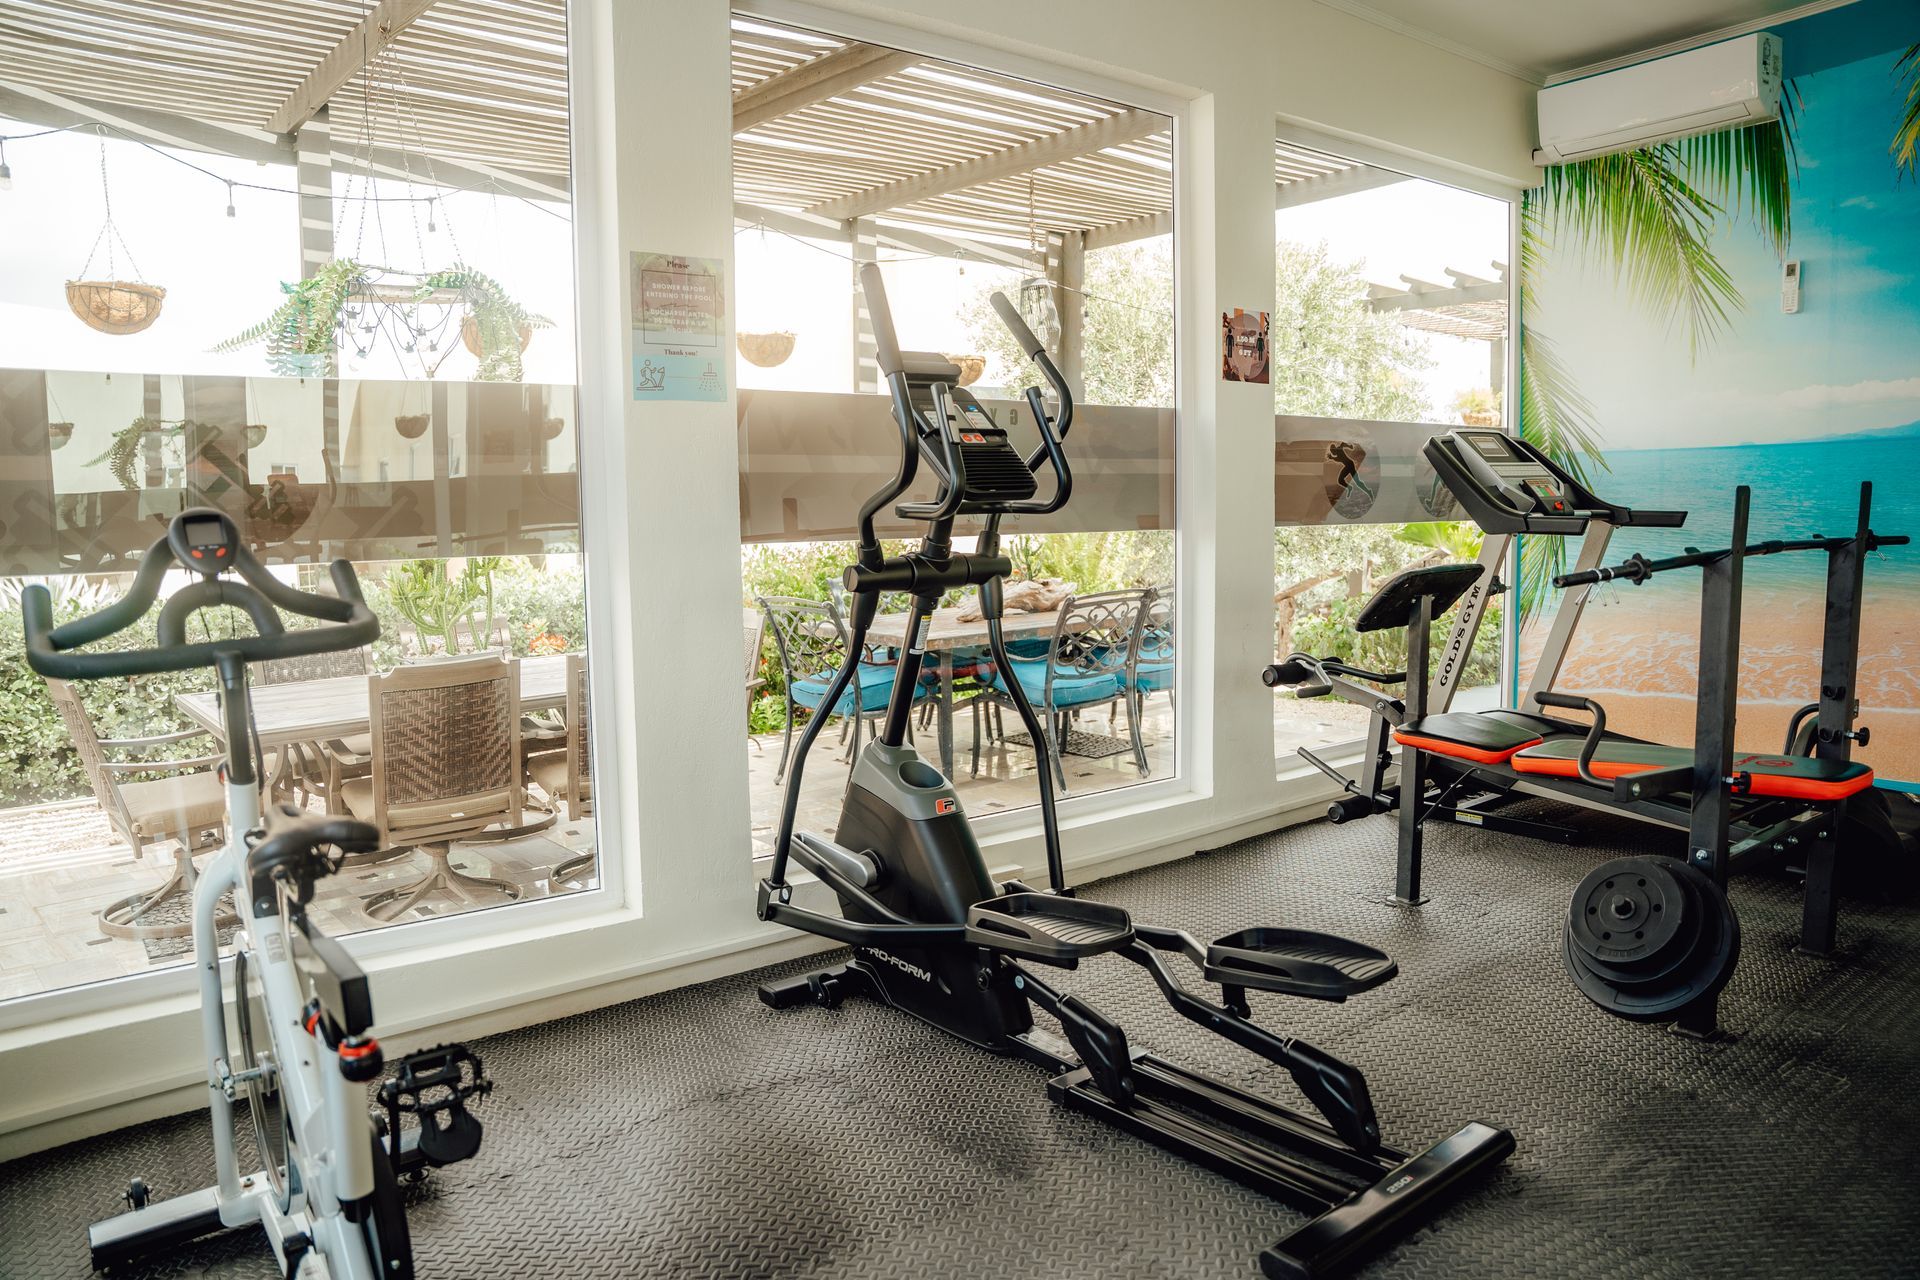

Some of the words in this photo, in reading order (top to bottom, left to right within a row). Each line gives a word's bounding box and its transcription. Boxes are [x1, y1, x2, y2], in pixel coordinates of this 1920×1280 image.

[666, 260, 690, 269] Please
[651, 282, 680, 290] SHOWER
[682, 284, 706, 292] BEFORE
[646, 291, 679, 299] ENTERING
[694, 294, 712, 302] POOL
[663, 348, 684, 356] Thank
[1439, 627, 1466, 687] GOLD'S
[1462, 584, 1481, 624] GYM
[861, 945, 931, 983] RO-FORM
